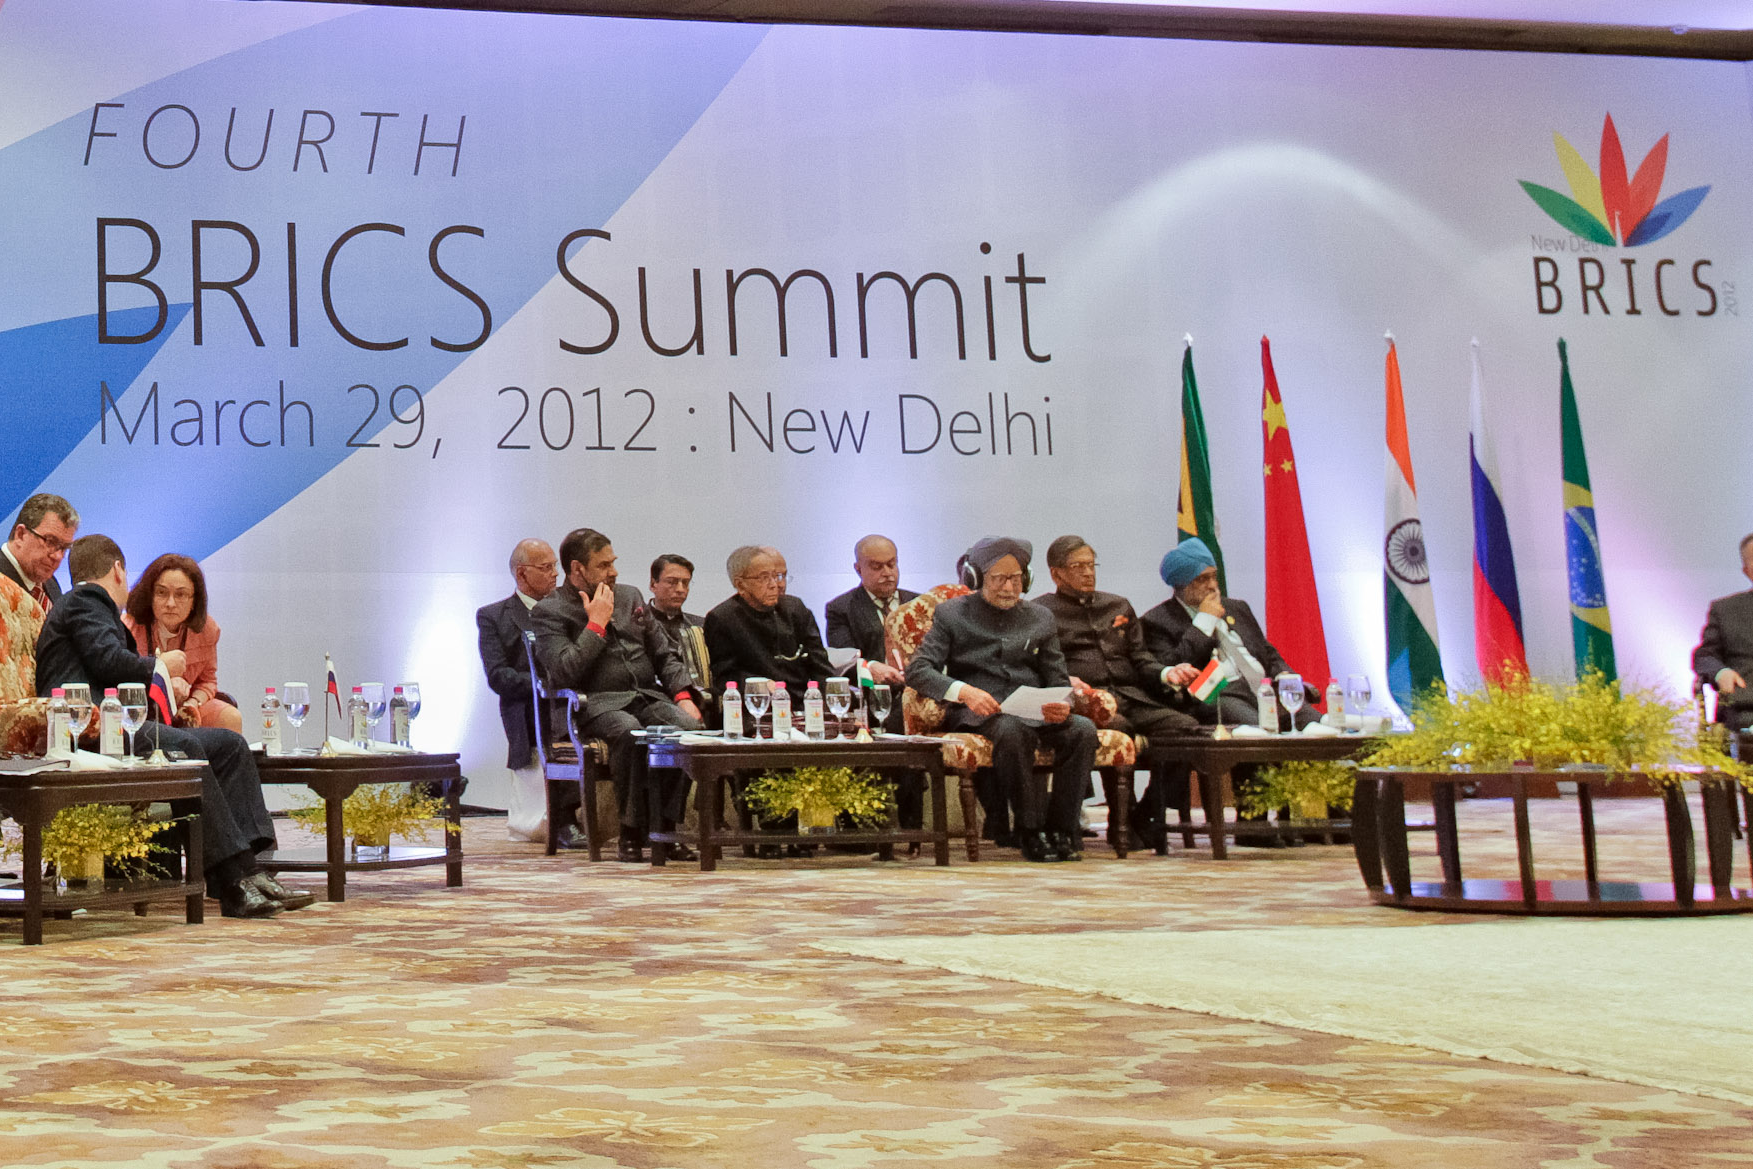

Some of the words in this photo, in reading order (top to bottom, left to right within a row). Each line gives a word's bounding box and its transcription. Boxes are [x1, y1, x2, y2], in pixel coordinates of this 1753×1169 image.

[83, 102, 467, 177] FOURTH
[96, 217, 494, 354] BRICS
[555, 228, 1053, 364] Summit
[1533, 256, 1717, 317] BRICS
[1721, 280, 1738, 317] 2012
[99, 380, 316, 448] March
[344, 384, 443, 459] 29,
[496, 386, 658, 452] 2012
[728, 391, 871, 455] New
[898, 392, 1054, 457] Delhi
